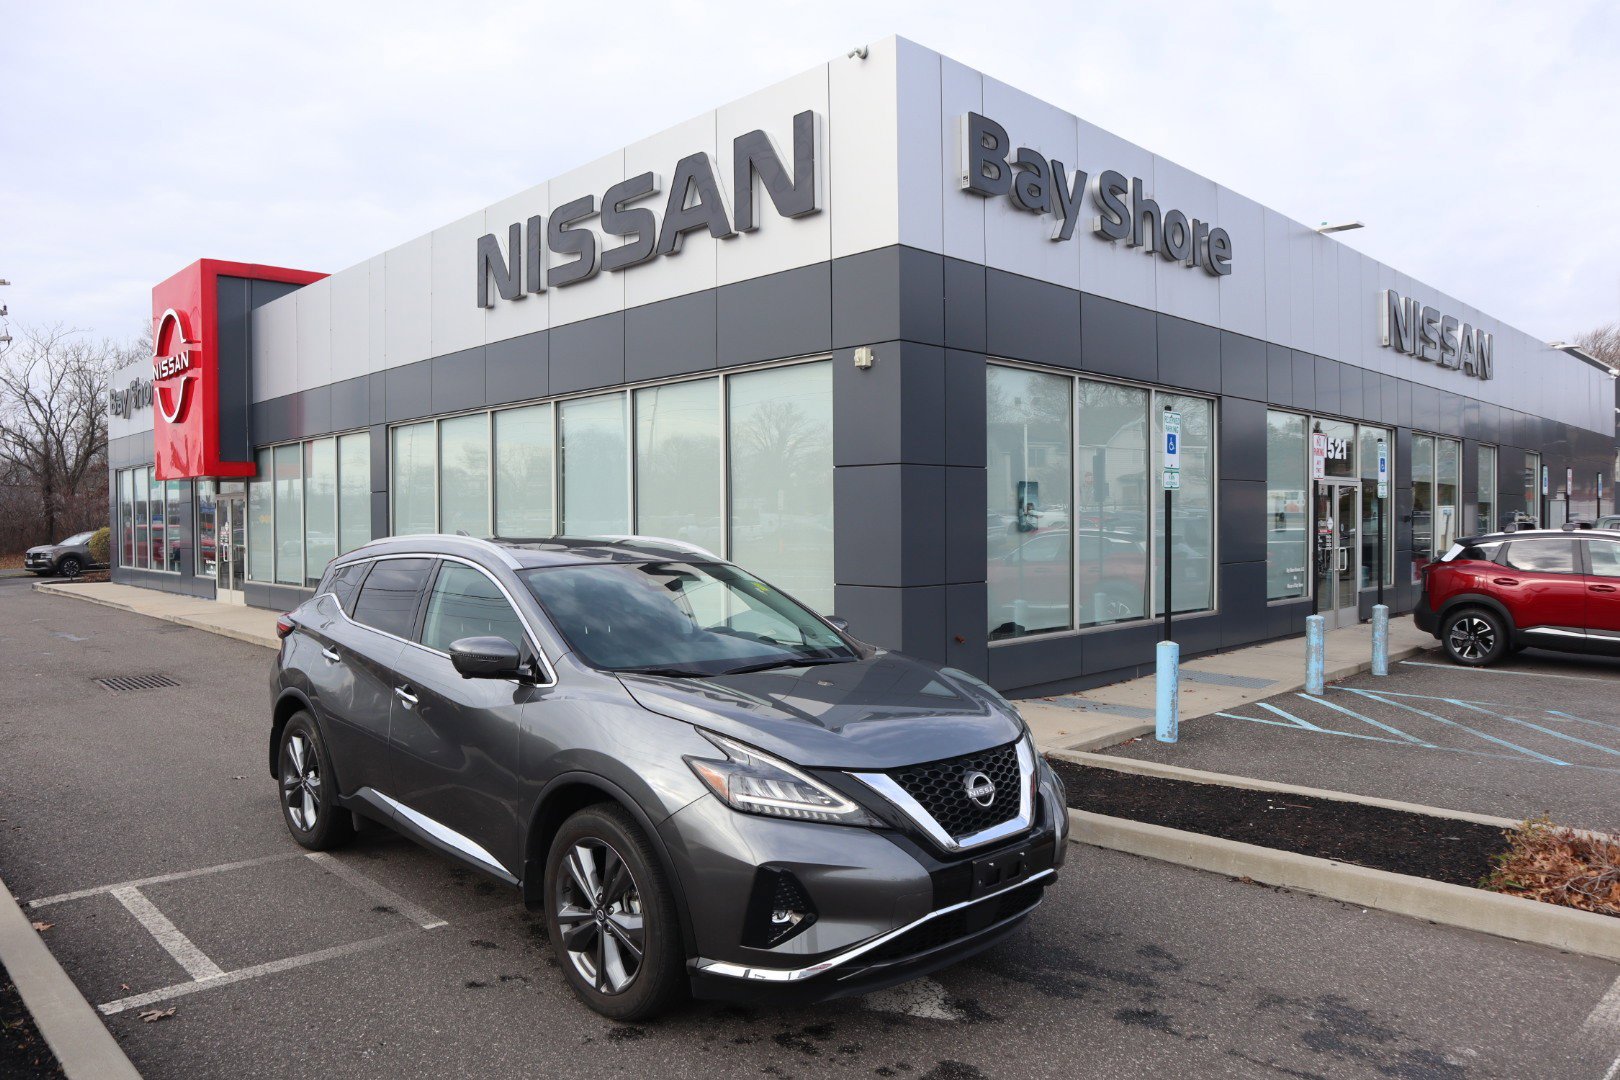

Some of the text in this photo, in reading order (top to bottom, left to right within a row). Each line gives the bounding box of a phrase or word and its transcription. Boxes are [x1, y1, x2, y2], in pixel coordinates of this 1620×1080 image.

[477, 109, 819, 308] NISSAN
[962, 111, 1233, 276] Bay Shore
[153, 350, 189, 380] NISSAN
[1383, 289, 1493, 380] NISSAN
[110, 388, 131, 420] Bay
